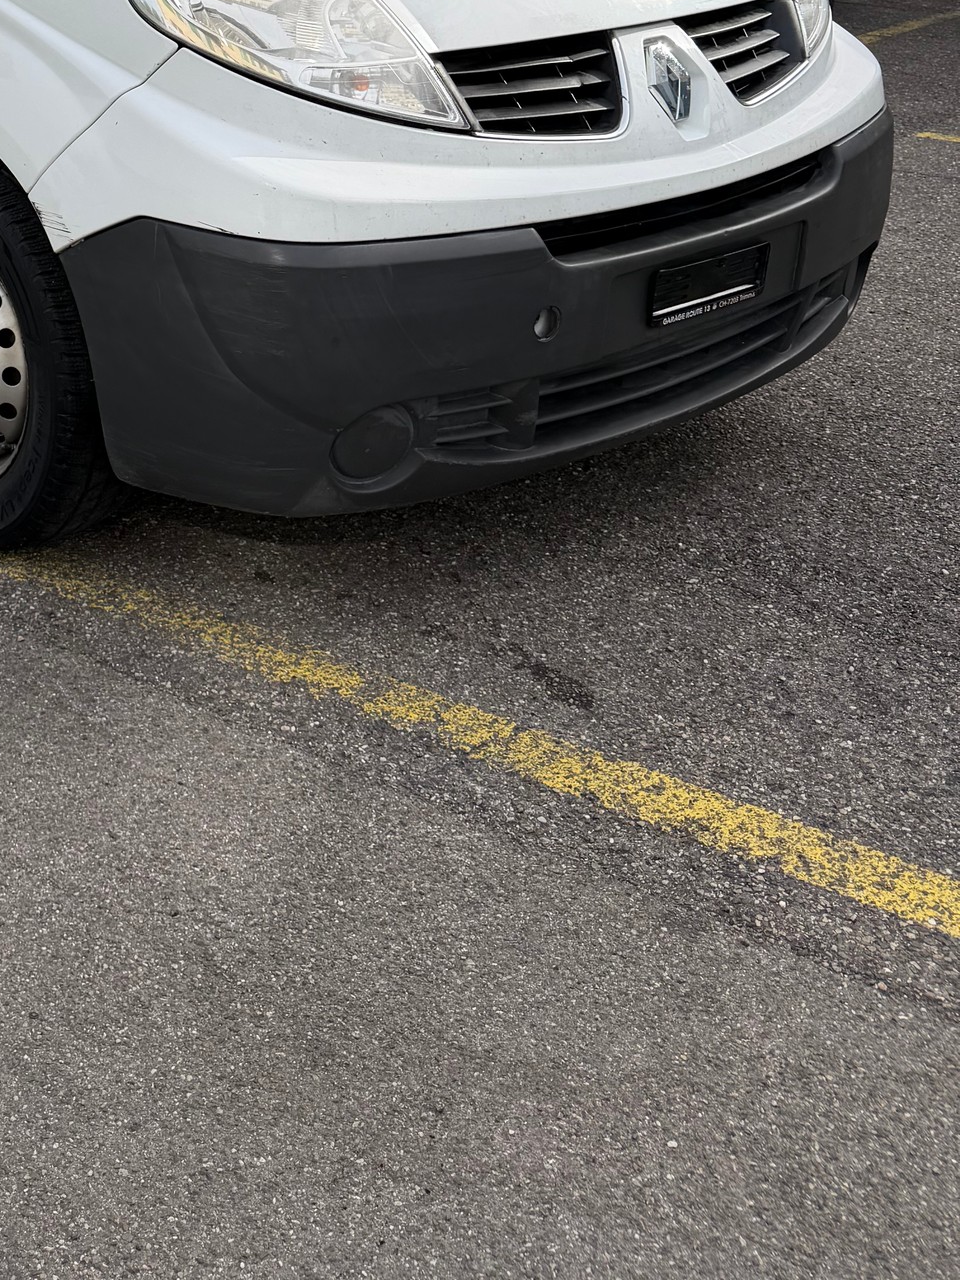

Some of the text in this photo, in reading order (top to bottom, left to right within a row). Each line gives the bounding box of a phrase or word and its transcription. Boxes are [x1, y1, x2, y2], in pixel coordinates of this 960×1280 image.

[662, 312, 686, 326] GARAGE
[685, 307, 703, 319] ROUTE
[704, 304, 711, 313] 13
